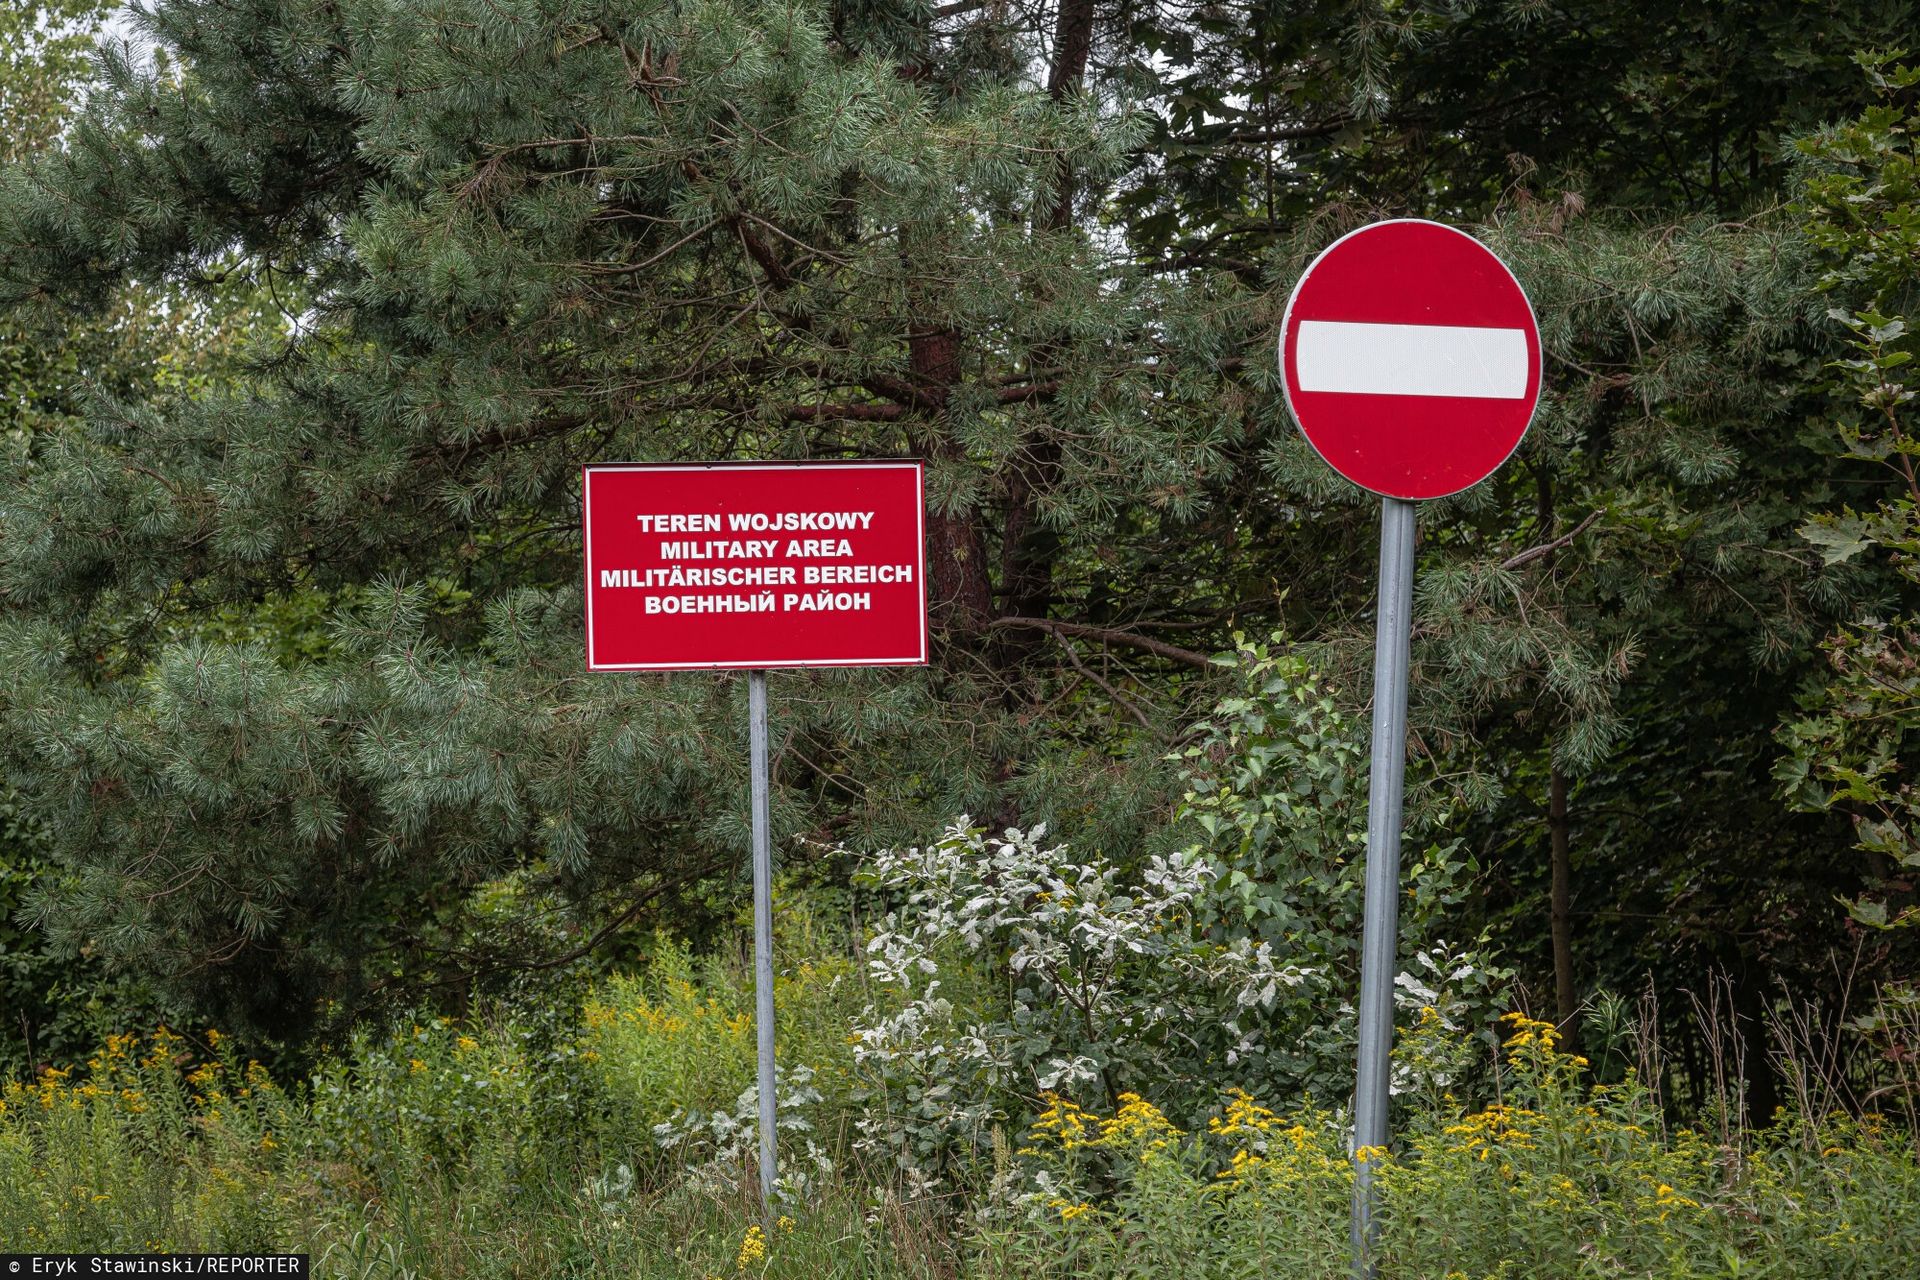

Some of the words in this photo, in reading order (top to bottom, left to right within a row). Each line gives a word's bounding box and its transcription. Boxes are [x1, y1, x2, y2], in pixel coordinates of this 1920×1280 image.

[637, 513, 721, 533] TEREN
[728, 511, 875, 532] WOJSKOWY
[660, 540, 779, 560] MILITARY
[785, 539, 854, 558] AREA
[600, 565, 796, 588] MILITÄRISCHER
[803, 565, 913, 585] BEREICH
[644, 590, 776, 614] ВОЕННЫЙ
[783, 589, 871, 611] РАЙОН
